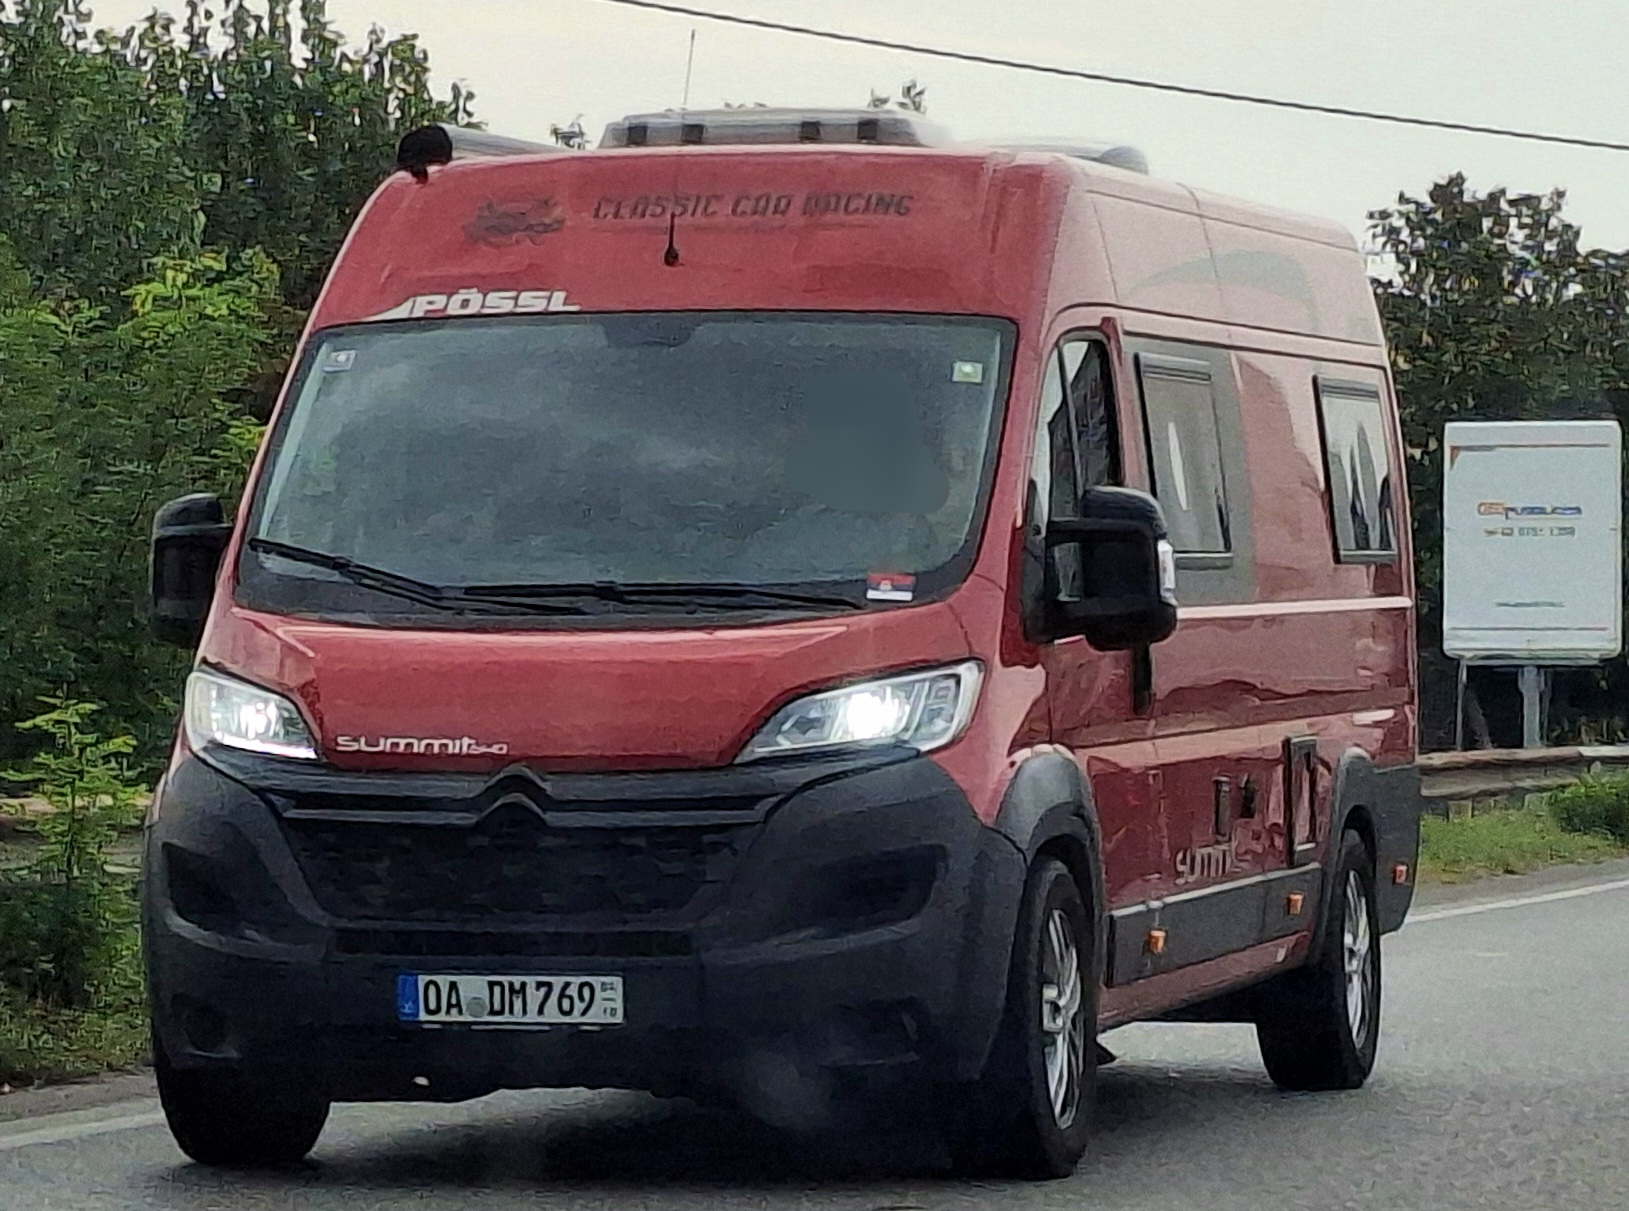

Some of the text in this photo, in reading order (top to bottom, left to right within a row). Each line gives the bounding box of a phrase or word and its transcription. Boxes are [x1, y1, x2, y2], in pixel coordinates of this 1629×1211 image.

[593, 193, 724, 220] CLASSIC
[410, 287, 581, 318] PÖSSL
[423, 979, 463, 1016] OA
